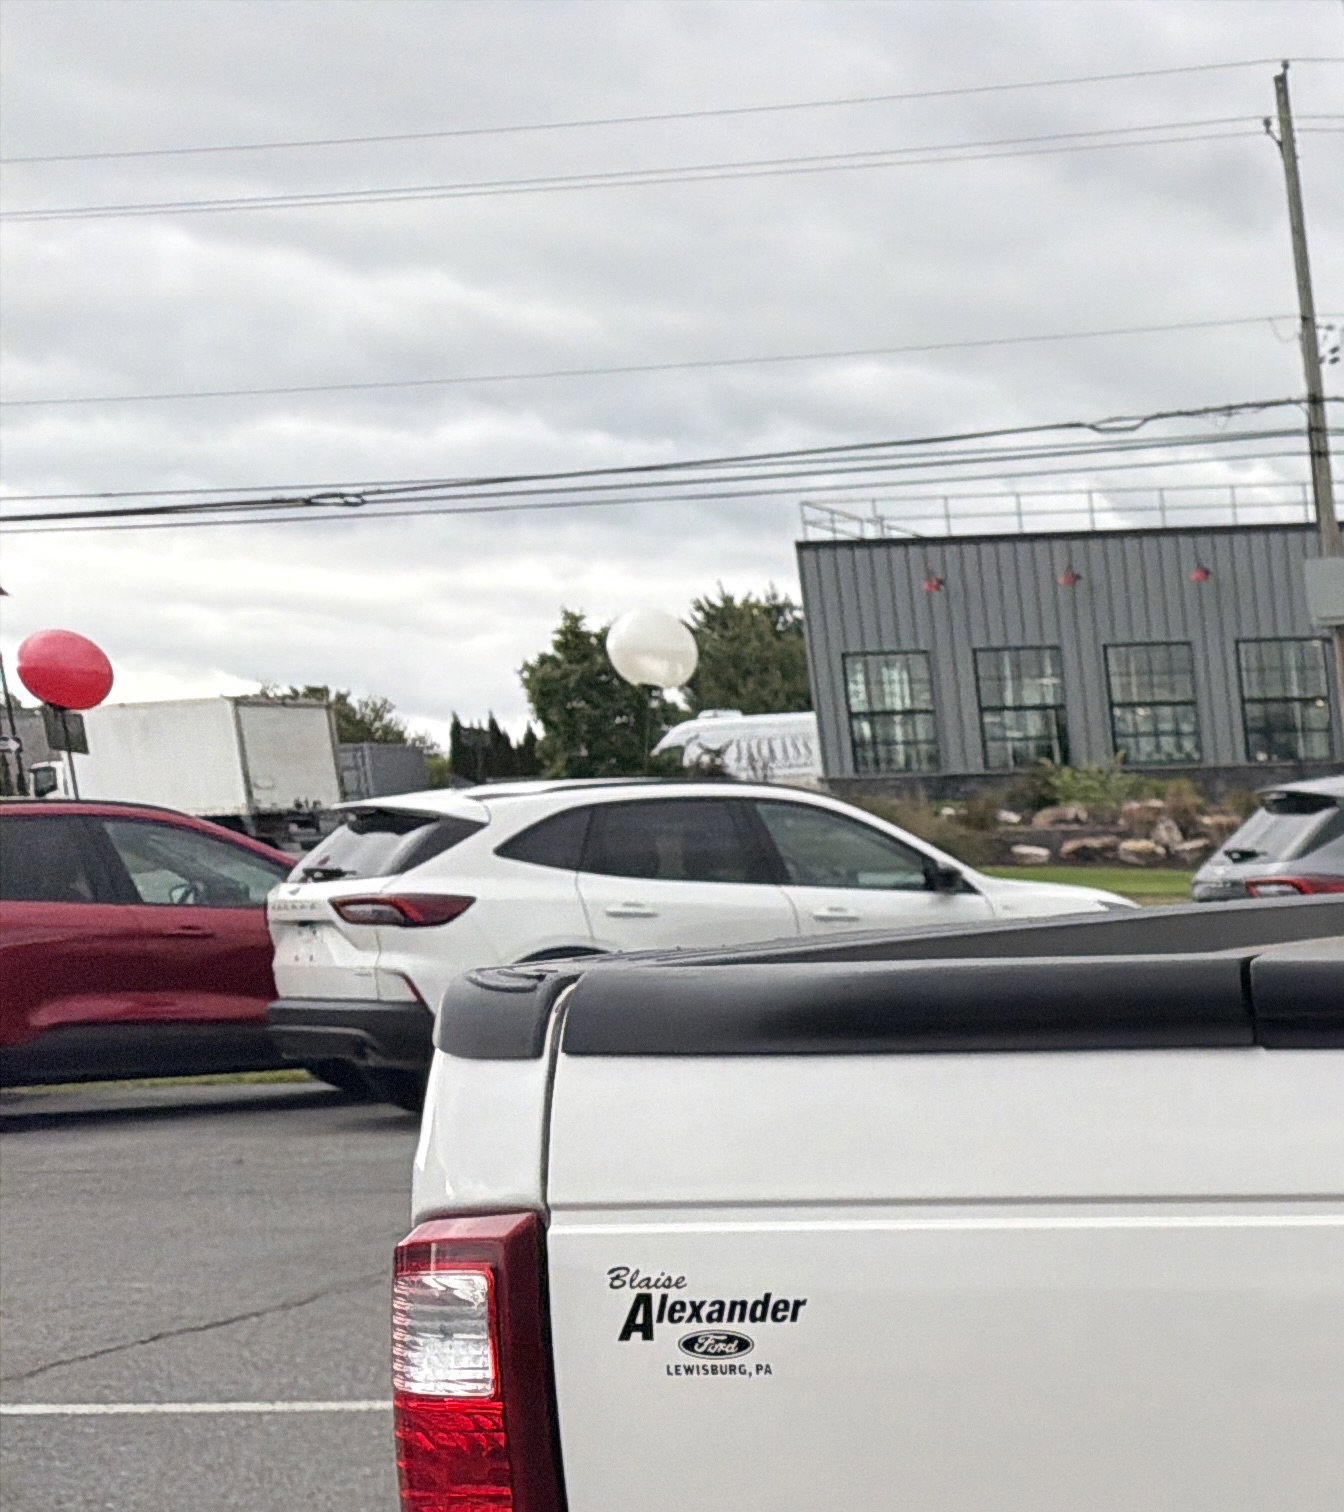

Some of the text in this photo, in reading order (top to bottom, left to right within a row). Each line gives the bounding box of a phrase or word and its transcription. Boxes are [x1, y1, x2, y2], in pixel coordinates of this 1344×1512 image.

[607, 1266, 687, 1289] Blaise
[618, 1292, 807, 1341] Alexander
[666, 1364, 772, 1377] LEWISBURG, PA
